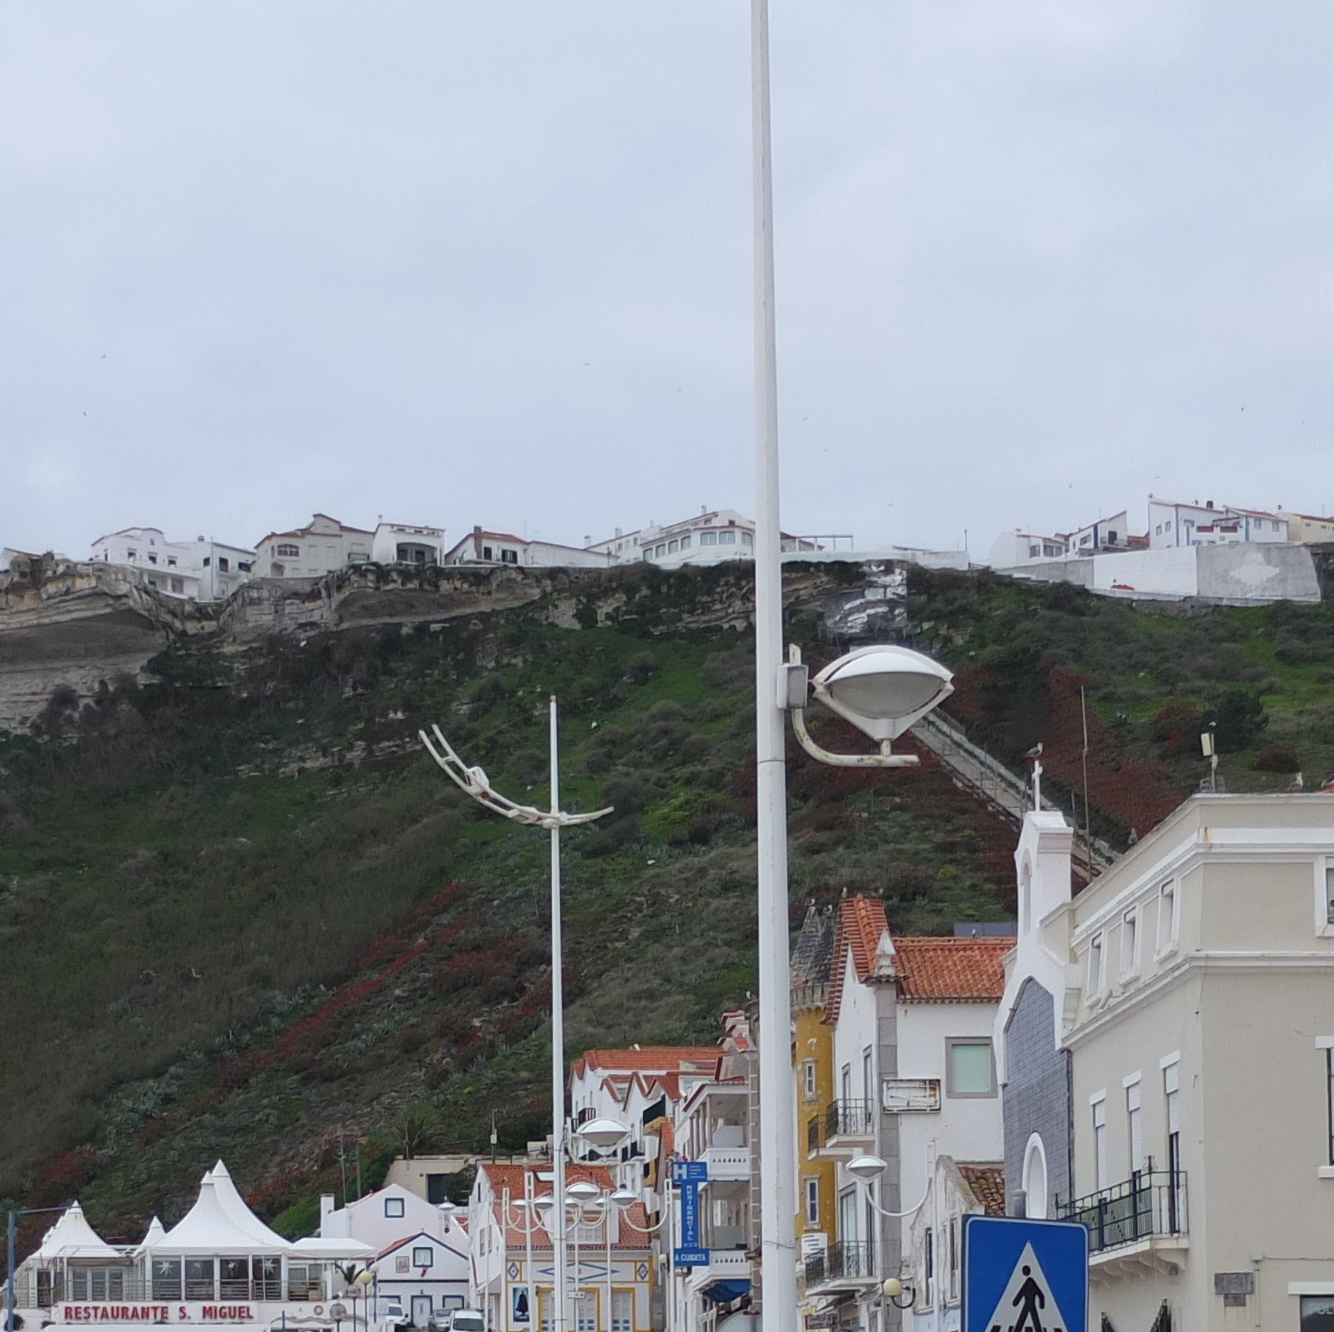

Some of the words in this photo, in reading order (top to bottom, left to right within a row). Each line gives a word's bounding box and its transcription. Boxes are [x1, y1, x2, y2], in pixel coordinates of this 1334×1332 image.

[64, 1305, 169, 1320] RESTAURANTE
[178, 1305, 192, 1320] S.
[202, 1305, 254, 1319] MIGUEL
